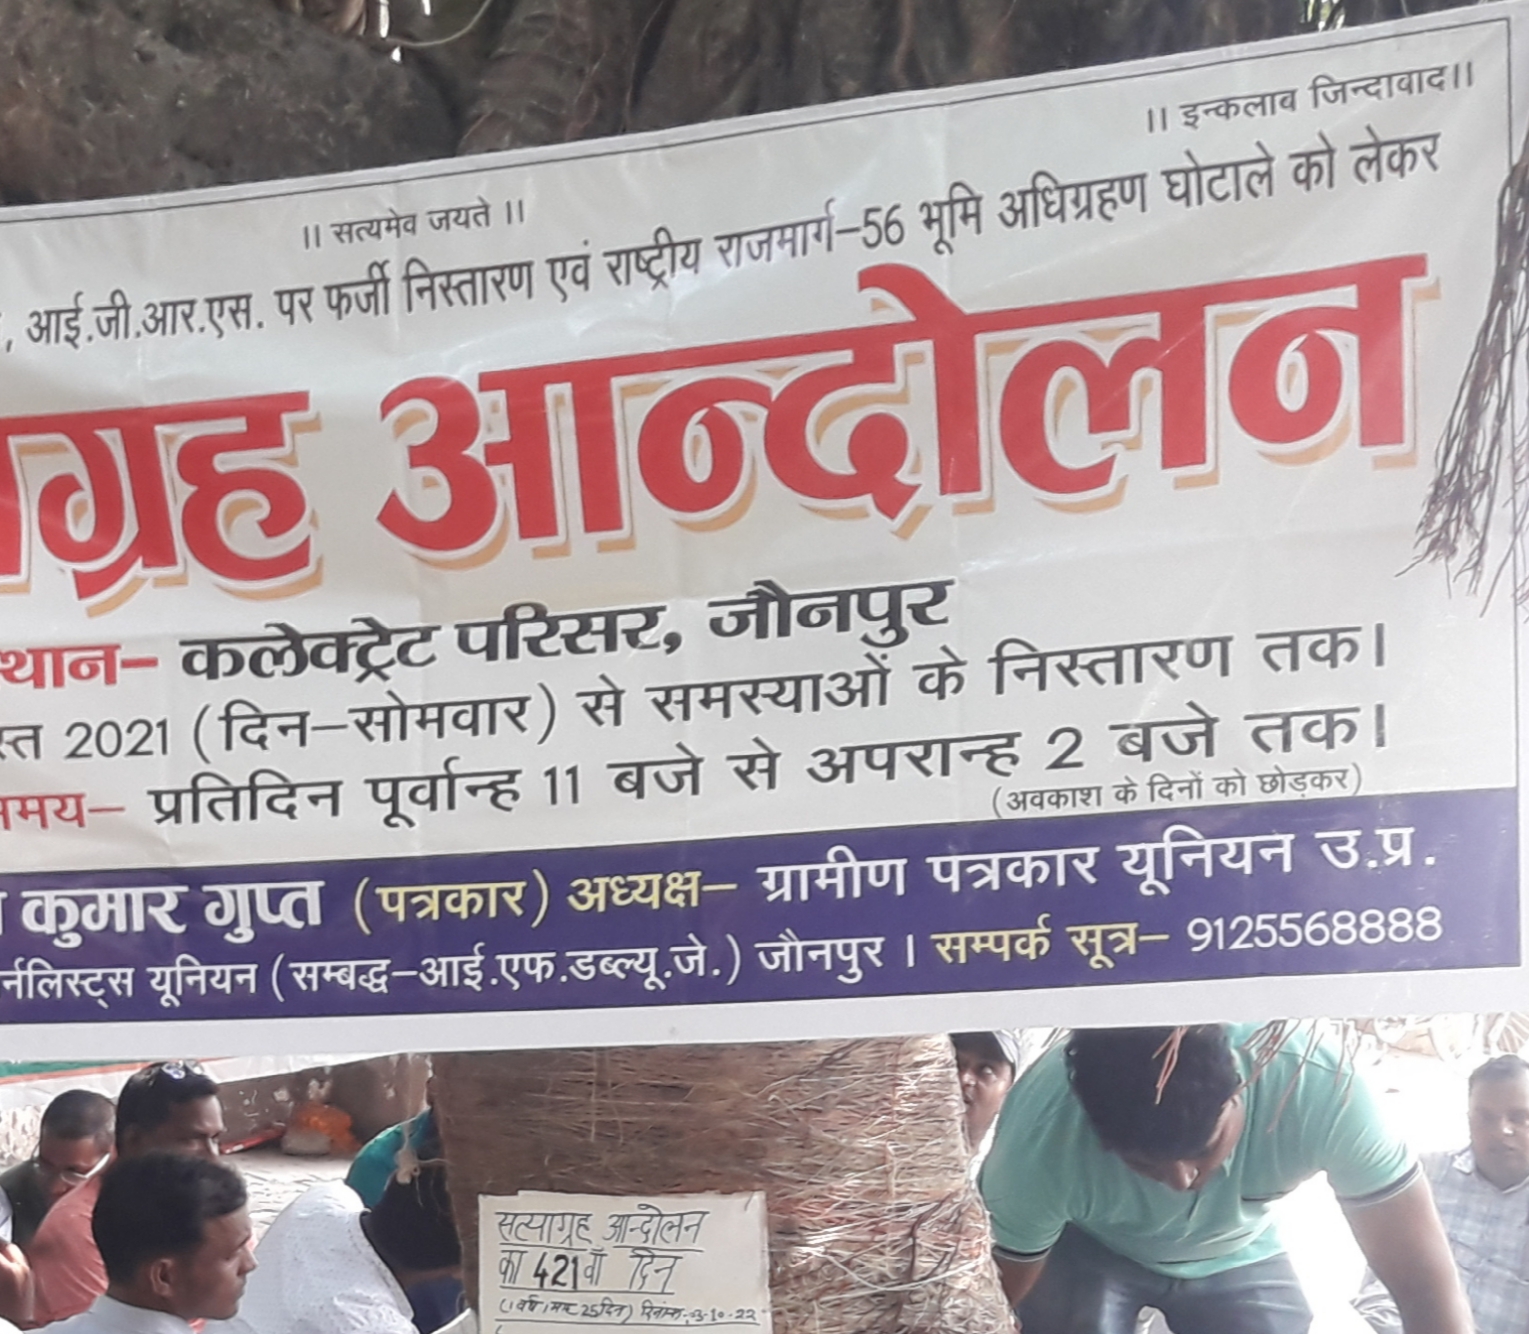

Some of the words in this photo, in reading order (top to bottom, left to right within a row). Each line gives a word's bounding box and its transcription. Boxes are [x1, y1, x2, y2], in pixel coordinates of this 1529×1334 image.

[275, 287, 314, 326] पर
[324, 260, 389, 321] फर्जी
[403, 258, 534, 314] निस्तारण
[547, 240, 591, 302] एवं
[603, 227, 701, 290] राष्ट्रीय
[919, 181, 982, 255] भूमि
[998, 171, 1147, 230] अधिग्रहण
[1162, 141, 1274, 208] घोटाले
[1290, 131, 1335, 192] को
[1350, 124, 1442, 185] लेकर
[331, 208, 416, 245] सत्यमेव
[427, 196, 490, 232] जयते
[376, 254, 1429, 553] आन्दोलन
[179, 617, 441, 683] कलेक्ट्रेट
[455, 601, 682, 662] परिसर,
[708, 579, 956, 648] जौनपुर
[64, 718, 169, 760] 2021
[577, 674, 625, 727] से
[645, 652, 891, 722] समस्याओं
[912, 644, 967, 700] के
[988, 637, 1233, 694] निस्तारण
[148, 768, 342, 825] प्रतिदिन
[365, 757, 522, 828] पूर्वान्ह
[543, 764, 578, 805] 11
[607, 742, 704, 799] बजे
[726, 736, 781, 791] से
[807, 731, 1022, 784] अपरान्ह
[1045, 726, 1084, 771] 2
[1109, 700, 1219, 762] बजे
[992, 786, 1102, 818] (अवकाश
[1113, 775, 1137, 804] के
[1148, 771, 1202, 801] दिनों
[1213, 769, 1246, 798] को
[21, 885, 188, 948] कुमार
[203, 880, 325, 943] गुप्त
[354, 869, 549, 935] (पत्रकार)
[756, 845, 908, 902] ग्रामीण
[925, 847, 1100, 892] पत्रकार
[1117, 824, 1294, 897] यूनियन
[1315, 826, 1435, 869] उ.प्र.
[147, 954, 258, 1007] यूनियन
[755, 928, 885, 983] जौनपुर
[931, 914, 1050, 963] सम्पर्क
[1186, 906, 1442, 952] 9125568888
[495, 1211, 593, 1244] सत्याग्रह
[602, 1204, 710, 1245] आन्दोलन
[499, 1250, 528, 1285] का
[629, 1247, 683, 1292] दिन
